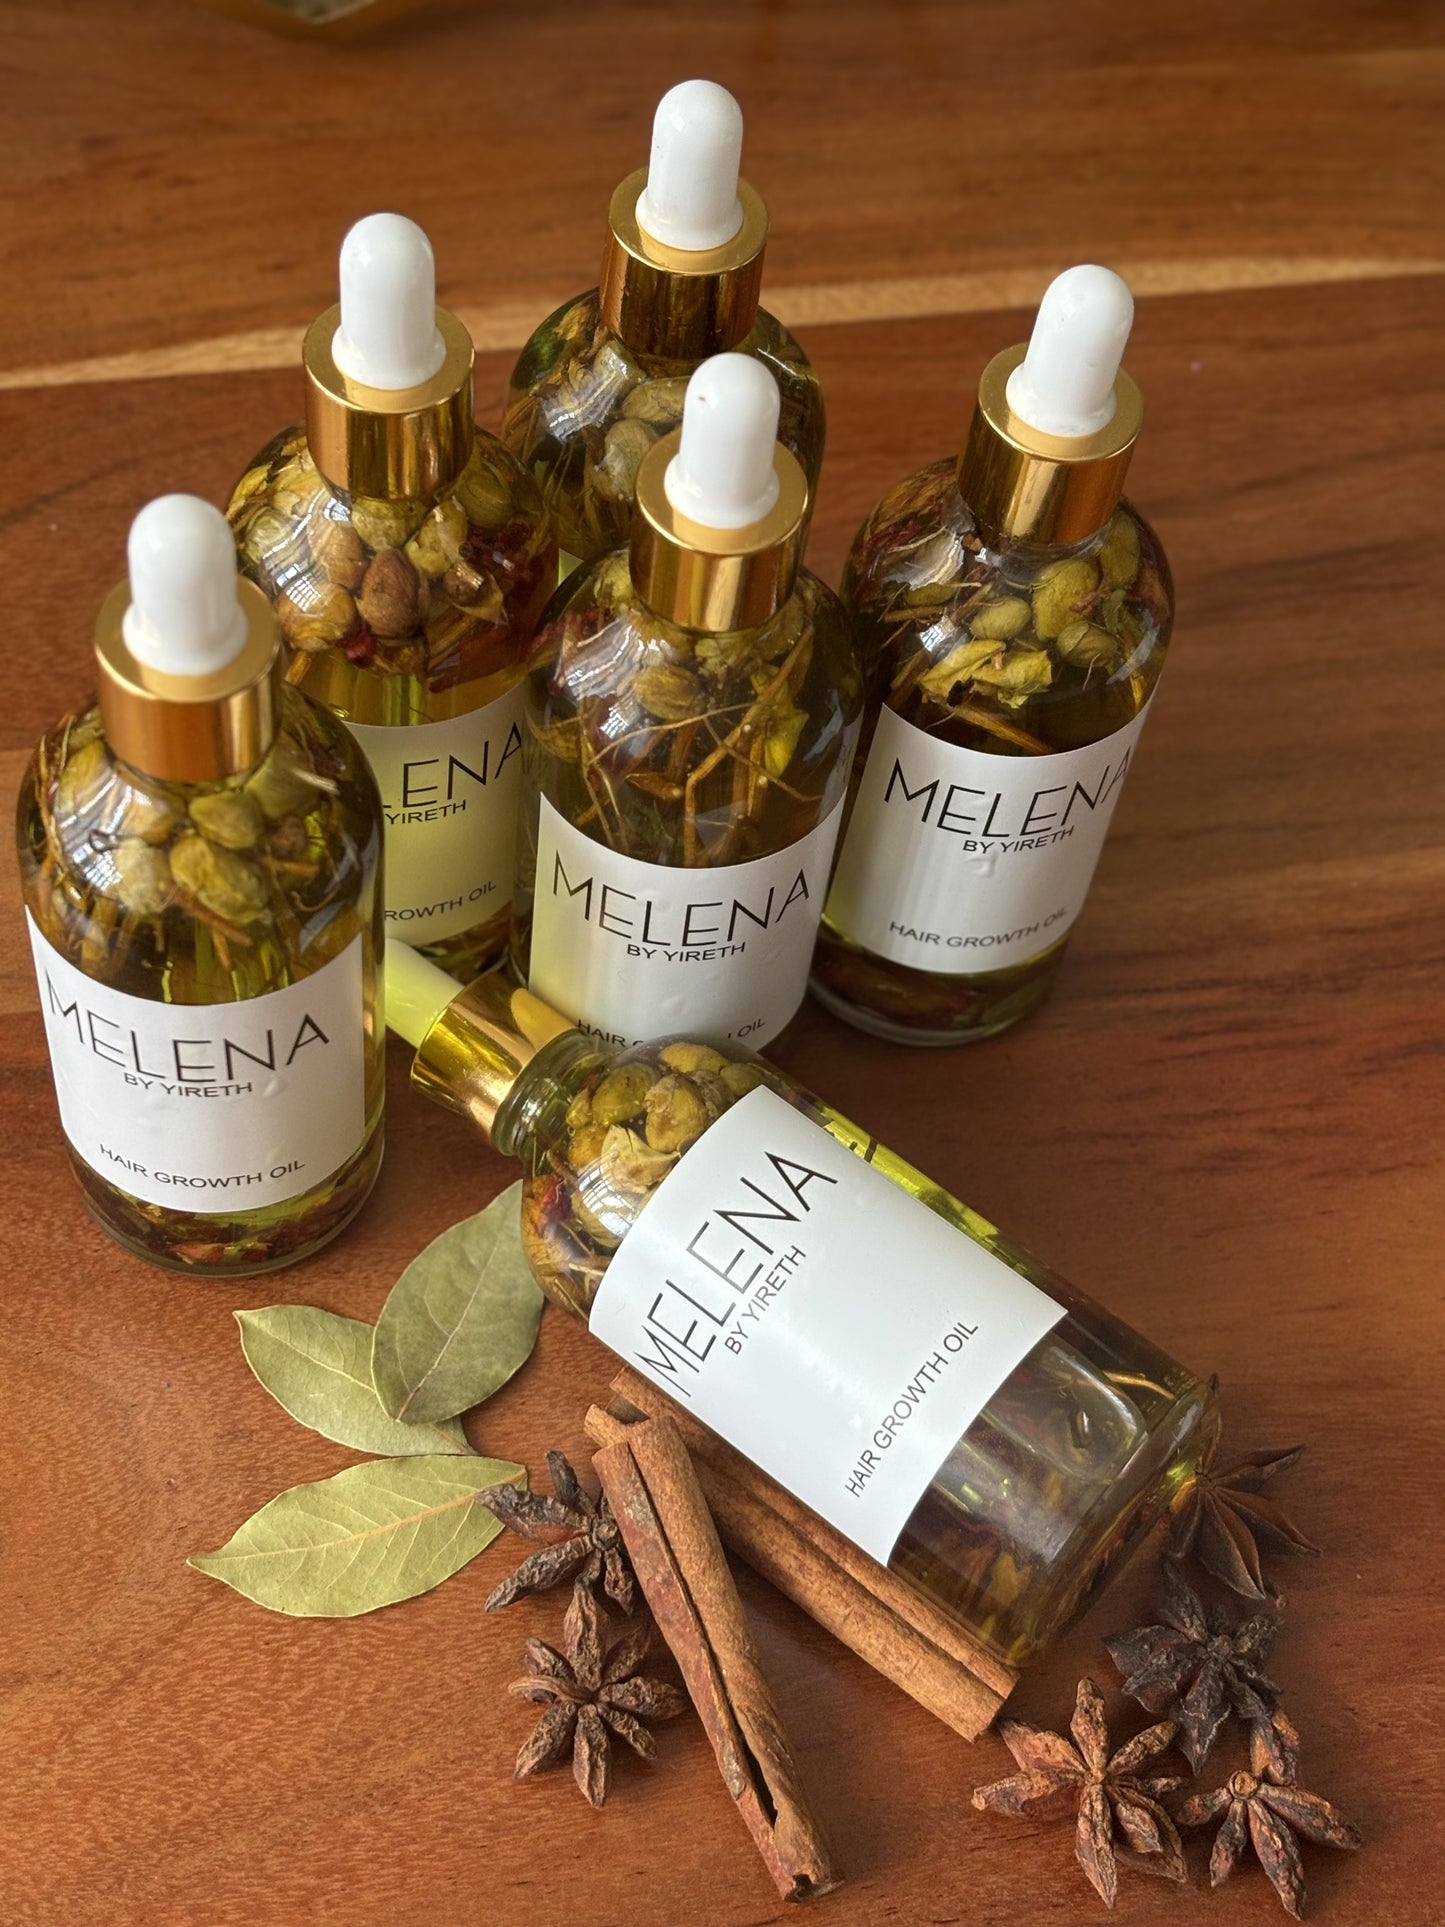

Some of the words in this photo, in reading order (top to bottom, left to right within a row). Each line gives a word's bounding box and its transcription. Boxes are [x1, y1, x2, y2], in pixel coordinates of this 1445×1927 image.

[383, 721, 522, 809] ENA
[385, 799, 467, 825] YIRETH
[884, 745, 1131, 838] MELENA
[963, 839, 994, 854] BY
[1000, 825, 1075, 853] YIRETH
[384, 897, 463, 921] ROWTH
[468, 881, 497, 902] OIL
[553, 850, 810, 947] MELENA
[889, 920, 941, 945] HAIR
[946, 922, 1040, 948] GROWTH
[1043, 906, 1067, 928] OIL
[627, 943, 657, 959] BY
[663, 942, 746, 962] YIRETH
[45, 968, 330, 1083] MELENA
[578, 1019, 626, 1047] HAIR
[737, 1018, 766, 1037] OIL
[124, 1072, 153, 1090] BY
[161, 1082, 253, 1098] YIRETH
[100, 1143, 148, 1178] HAIR
[154, 1171, 262, 1188] GROWTH
[270, 1160, 306, 1179] OIL
[633, 1151, 839, 1398] MELENA
[724, 1321, 749, 1356] BY
[743, 1244, 807, 1325] YIRETH
[844, 1448, 882, 1498] HAIR
[873, 1352, 949, 1450] GROWTH
[943, 1320, 979, 1353] OIL
